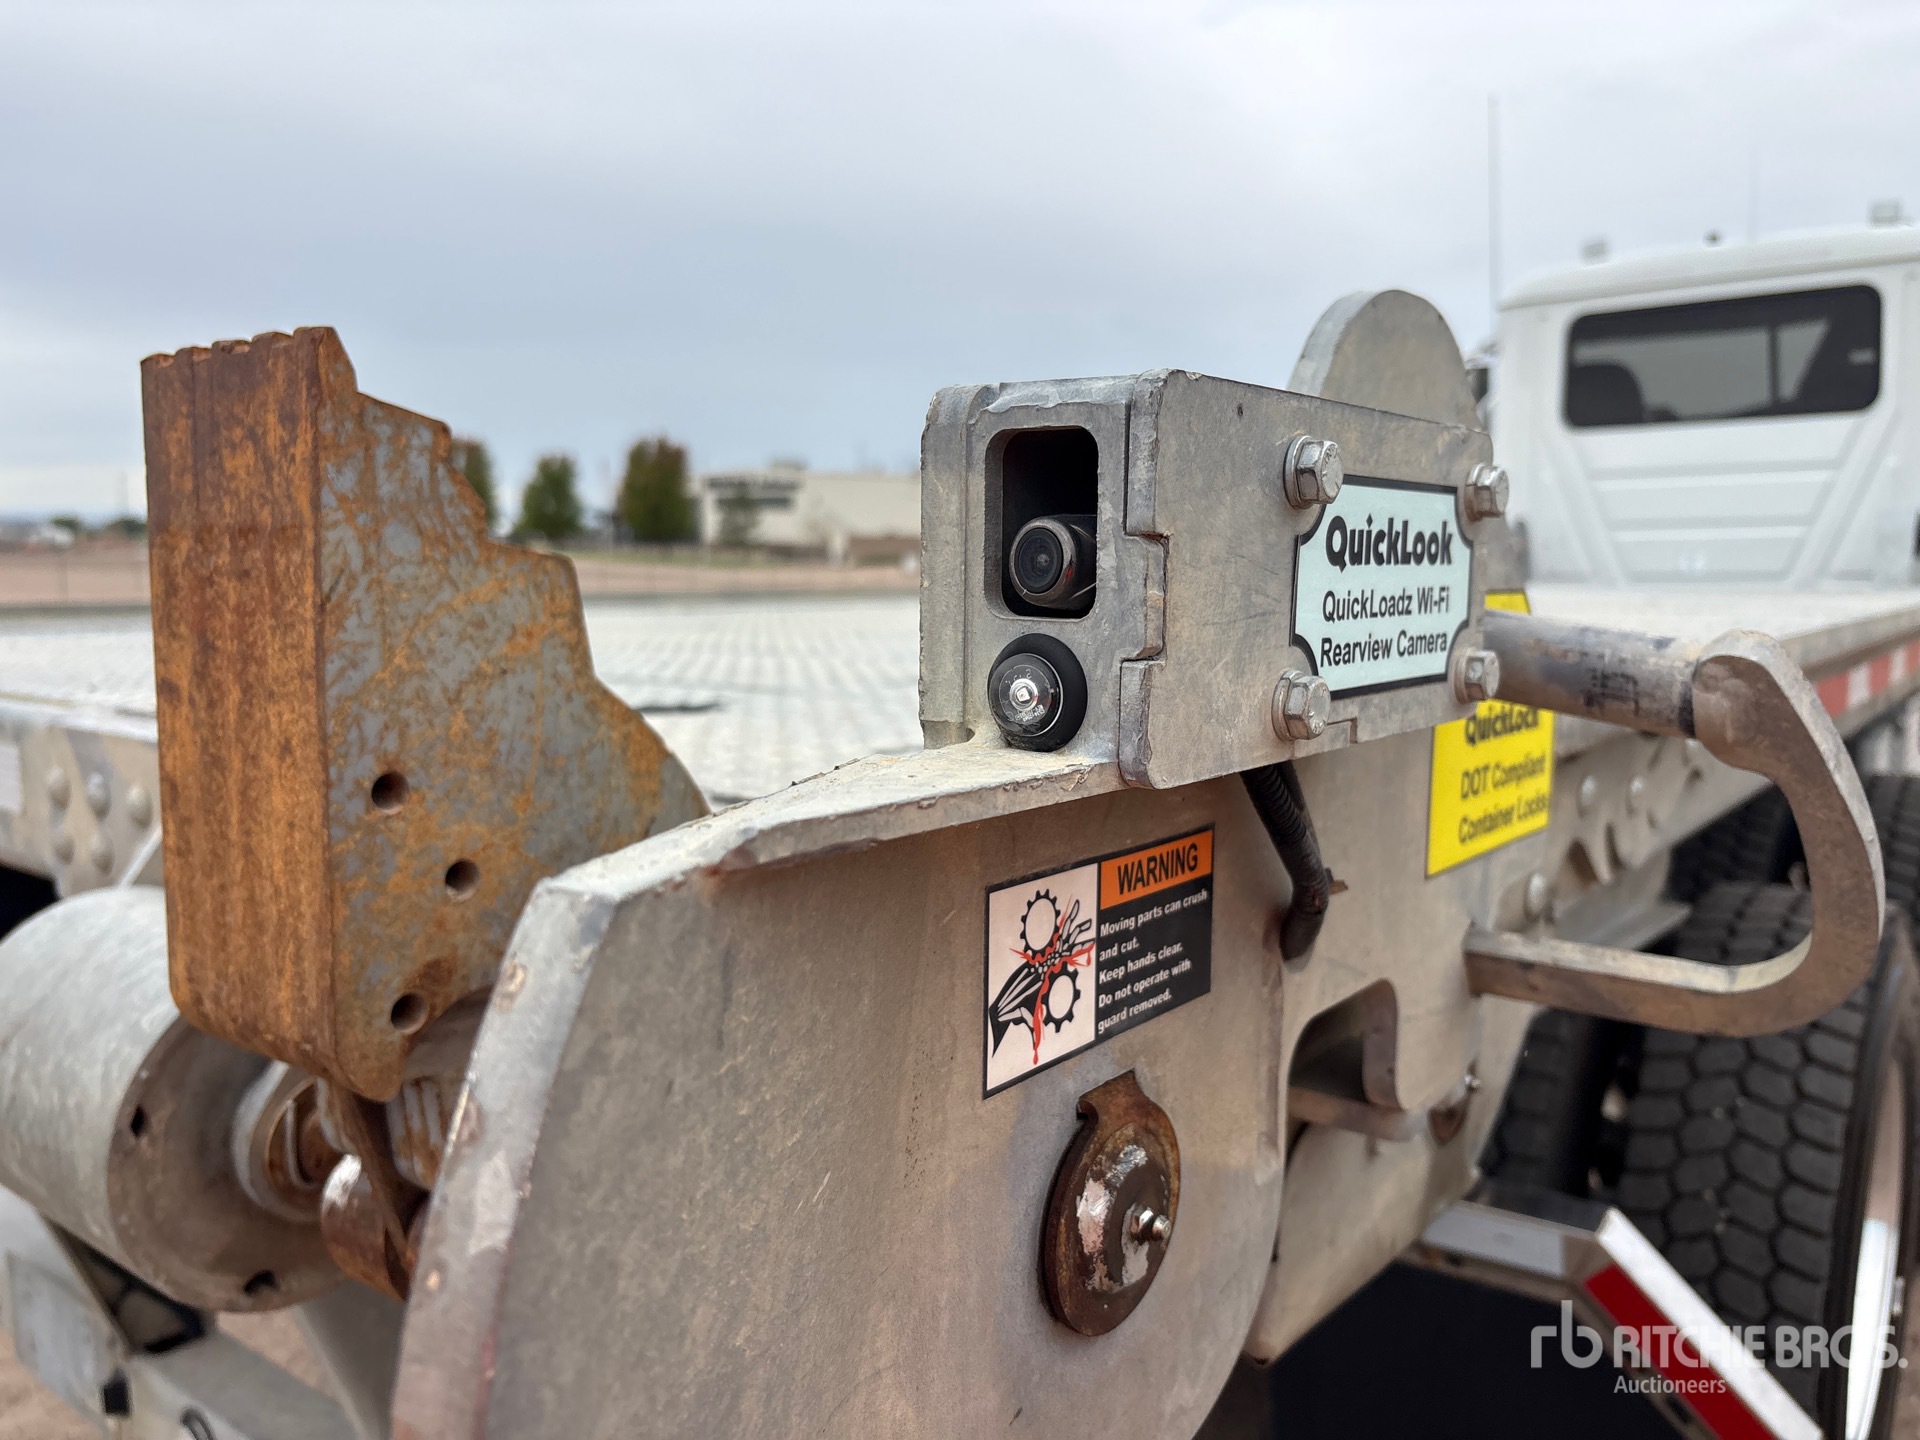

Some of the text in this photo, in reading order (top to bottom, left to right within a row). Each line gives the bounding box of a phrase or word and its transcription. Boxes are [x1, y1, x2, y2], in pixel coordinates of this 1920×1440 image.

[1325, 513, 1453, 574] QuickLook
[1322, 586, 1450, 624] QuickLoadz Wi-Fi
[1320, 630, 1448, 668] Rearview Camera
[1460, 763, 1490, 800] DOT
[1459, 802, 1515, 844] Container
[1117, 842, 1199, 895] WARNING
[1100, 888, 1208, 938] Moving parts can crush
[1099, 939, 1140, 961] and cut.
[1099, 942, 1183, 984] Keep hands clear.
[1098, 958, 1191, 1008] Do not operate with
[1098, 987, 1172, 1035] guard removed.
